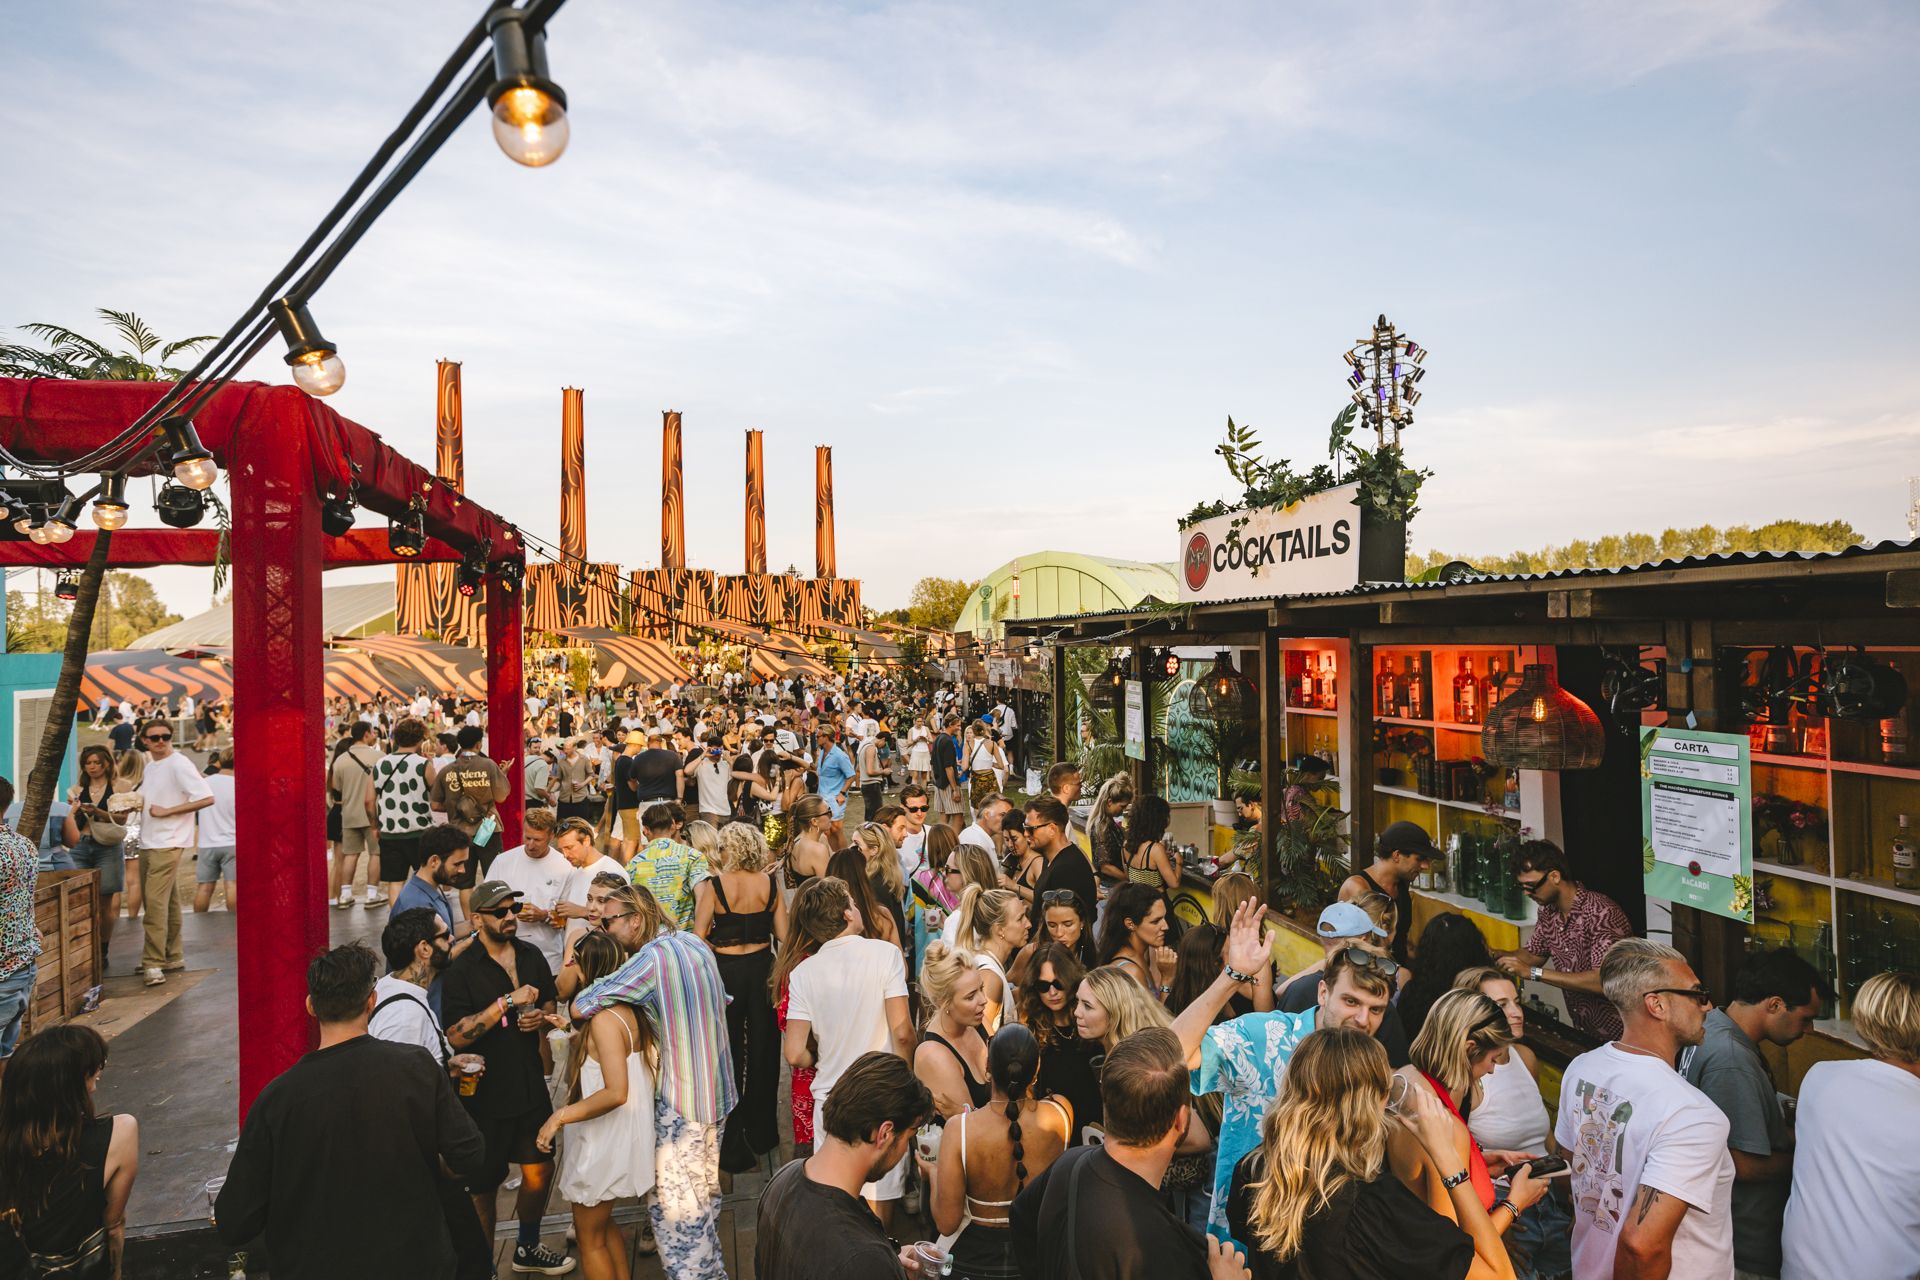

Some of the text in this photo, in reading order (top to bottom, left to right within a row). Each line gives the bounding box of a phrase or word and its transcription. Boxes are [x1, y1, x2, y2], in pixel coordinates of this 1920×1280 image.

[1213, 519, 1350, 573] COCKTAILS
[1674, 742, 1710, 754] CARTA
[445, 770, 488, 782] gardens
[463, 777, 490, 788] seeds
